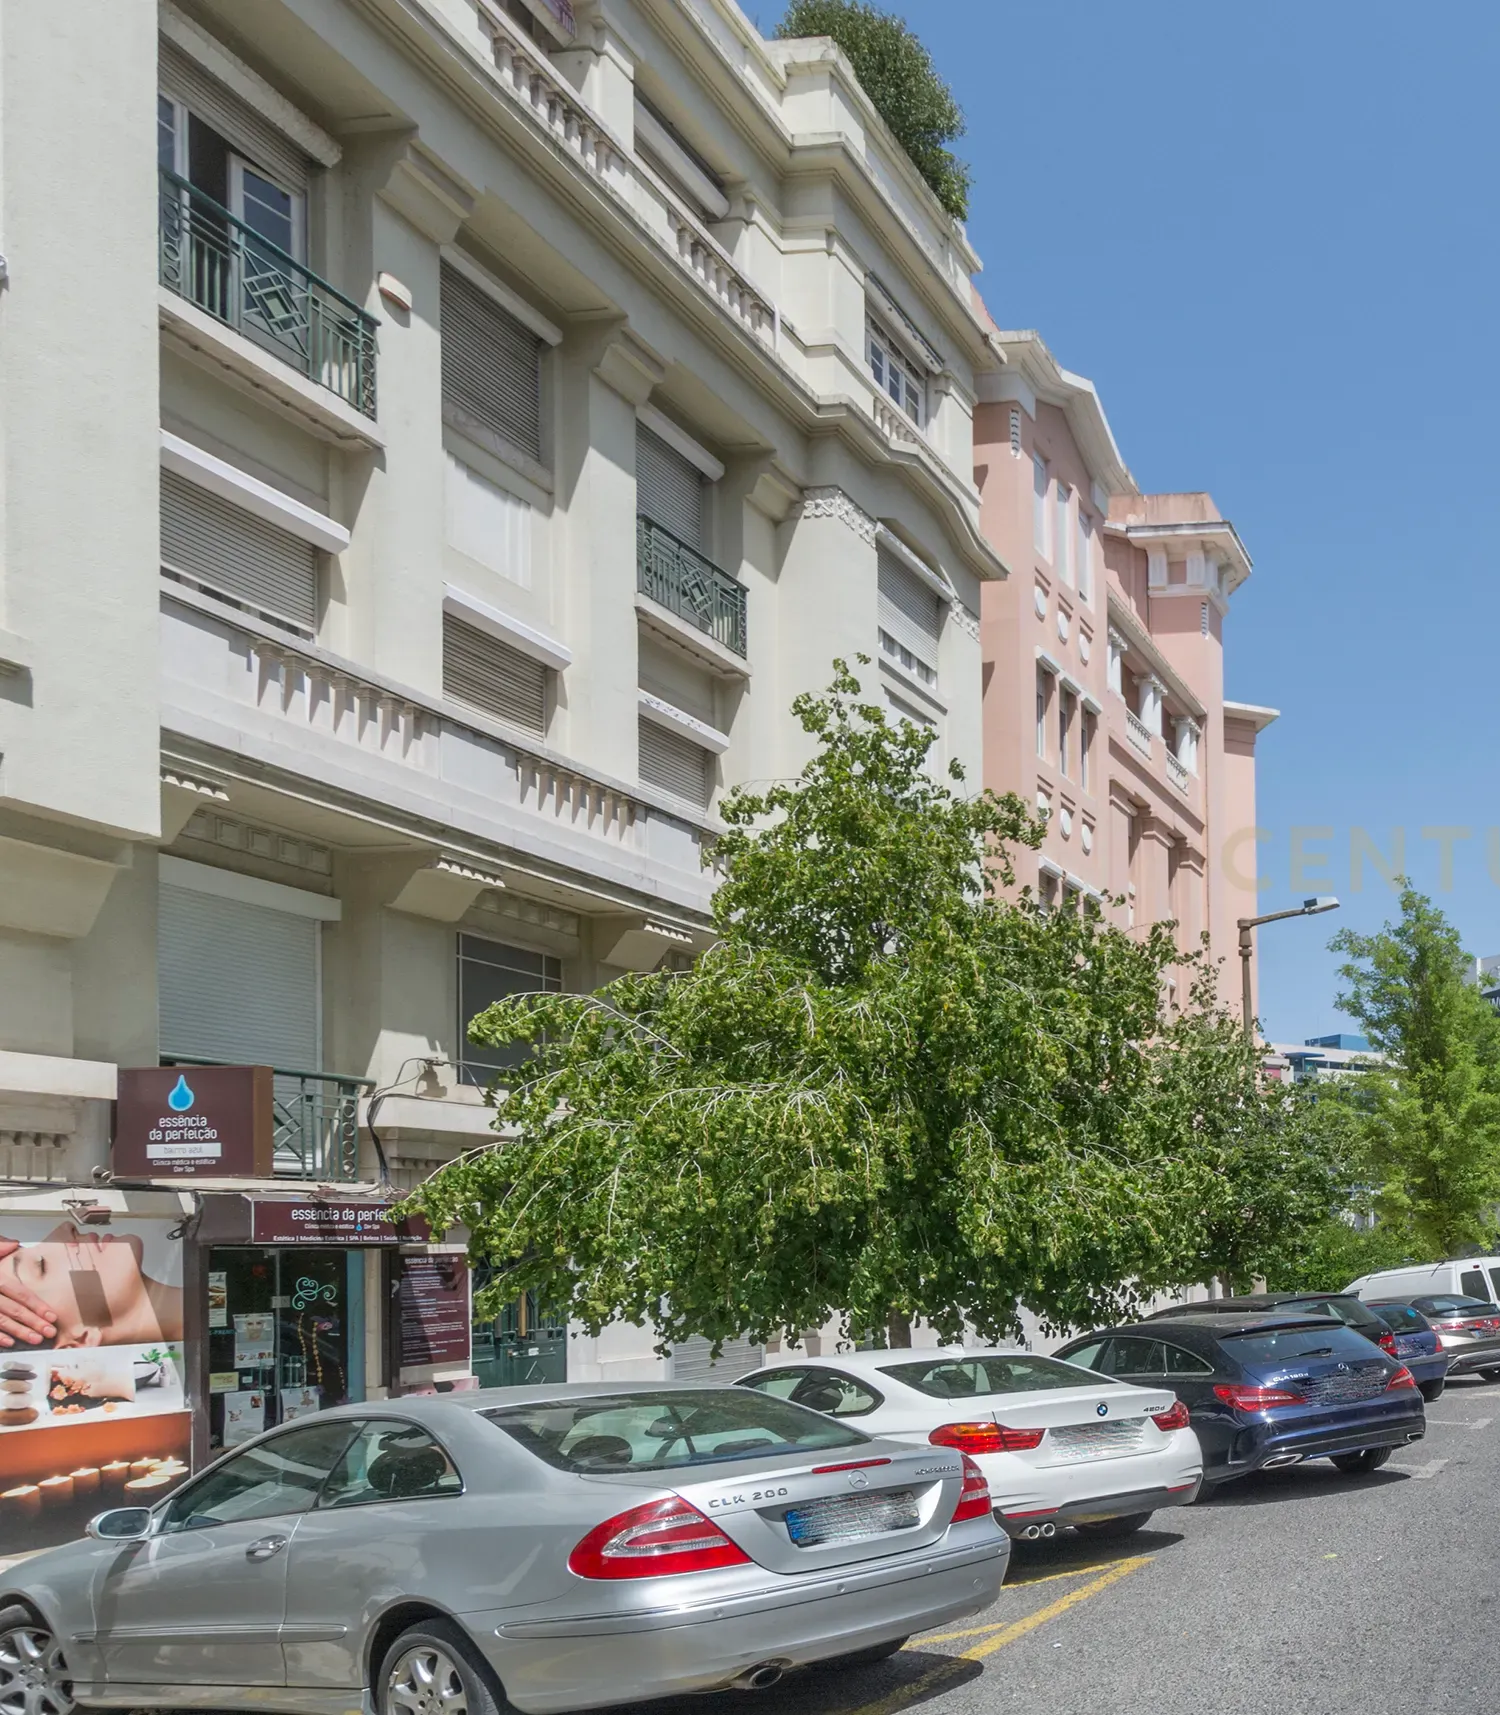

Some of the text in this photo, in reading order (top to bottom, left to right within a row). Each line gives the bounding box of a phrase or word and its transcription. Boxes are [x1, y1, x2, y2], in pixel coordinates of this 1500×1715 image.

[158, 1114, 208, 1128] essência
[149, 1127, 218, 1142] da perfeição
[291, 1208, 339, 1221] essência
[342, 1208, 355, 1220] da
[1143, 1405, 1166, 1413] 420d
[708, 1487, 788, 1509] CLK 200
